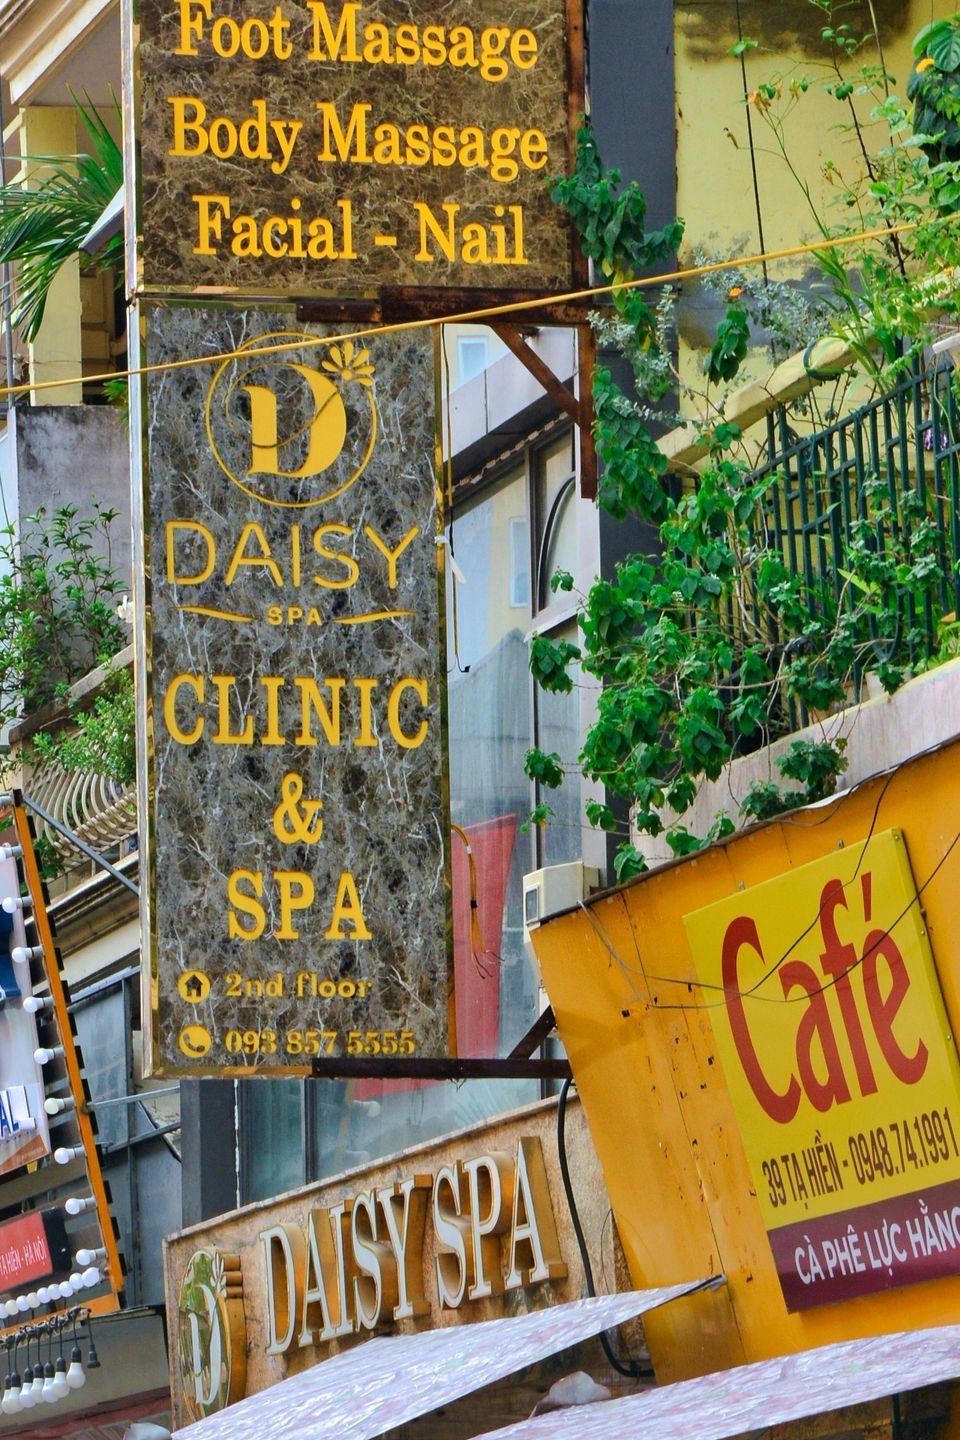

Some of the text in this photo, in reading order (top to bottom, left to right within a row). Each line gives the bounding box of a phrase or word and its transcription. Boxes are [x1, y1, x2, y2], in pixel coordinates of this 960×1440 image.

[174, 0, 538, 82] Foot Massage
[168, 96, 548, 183] Body Massage
[192, 195, 529, 265] Facial - Nail
[166, 521, 421, 590] DAISY
[268, 606, 322, 626] SPA
[164, 675, 429, 749] CLINIC
[273, 773, 324, 844] &
[228, 870, 372, 941] SPA
[225, 972, 372, 999] 2nd floor
[721, 872, 929, 1125] Café
[225, 1030, 415, 1057] 093 857 5555
[762, 1158, 787, 1208] 39
[781, 1152, 809, 1210] TẠ
[802, 1129, 844, 1198] HIỀN
[848, 1106, 960, 1185] 0948.74.1991
[259, 1179, 418, 1355] DAISY
[433, 1137, 552, 1310] SPA
[794, 1235, 825, 1285] CÀ
[822, 1224, 866, 1278] PHÊ
[864, 1218, 908, 1277] LỰC
